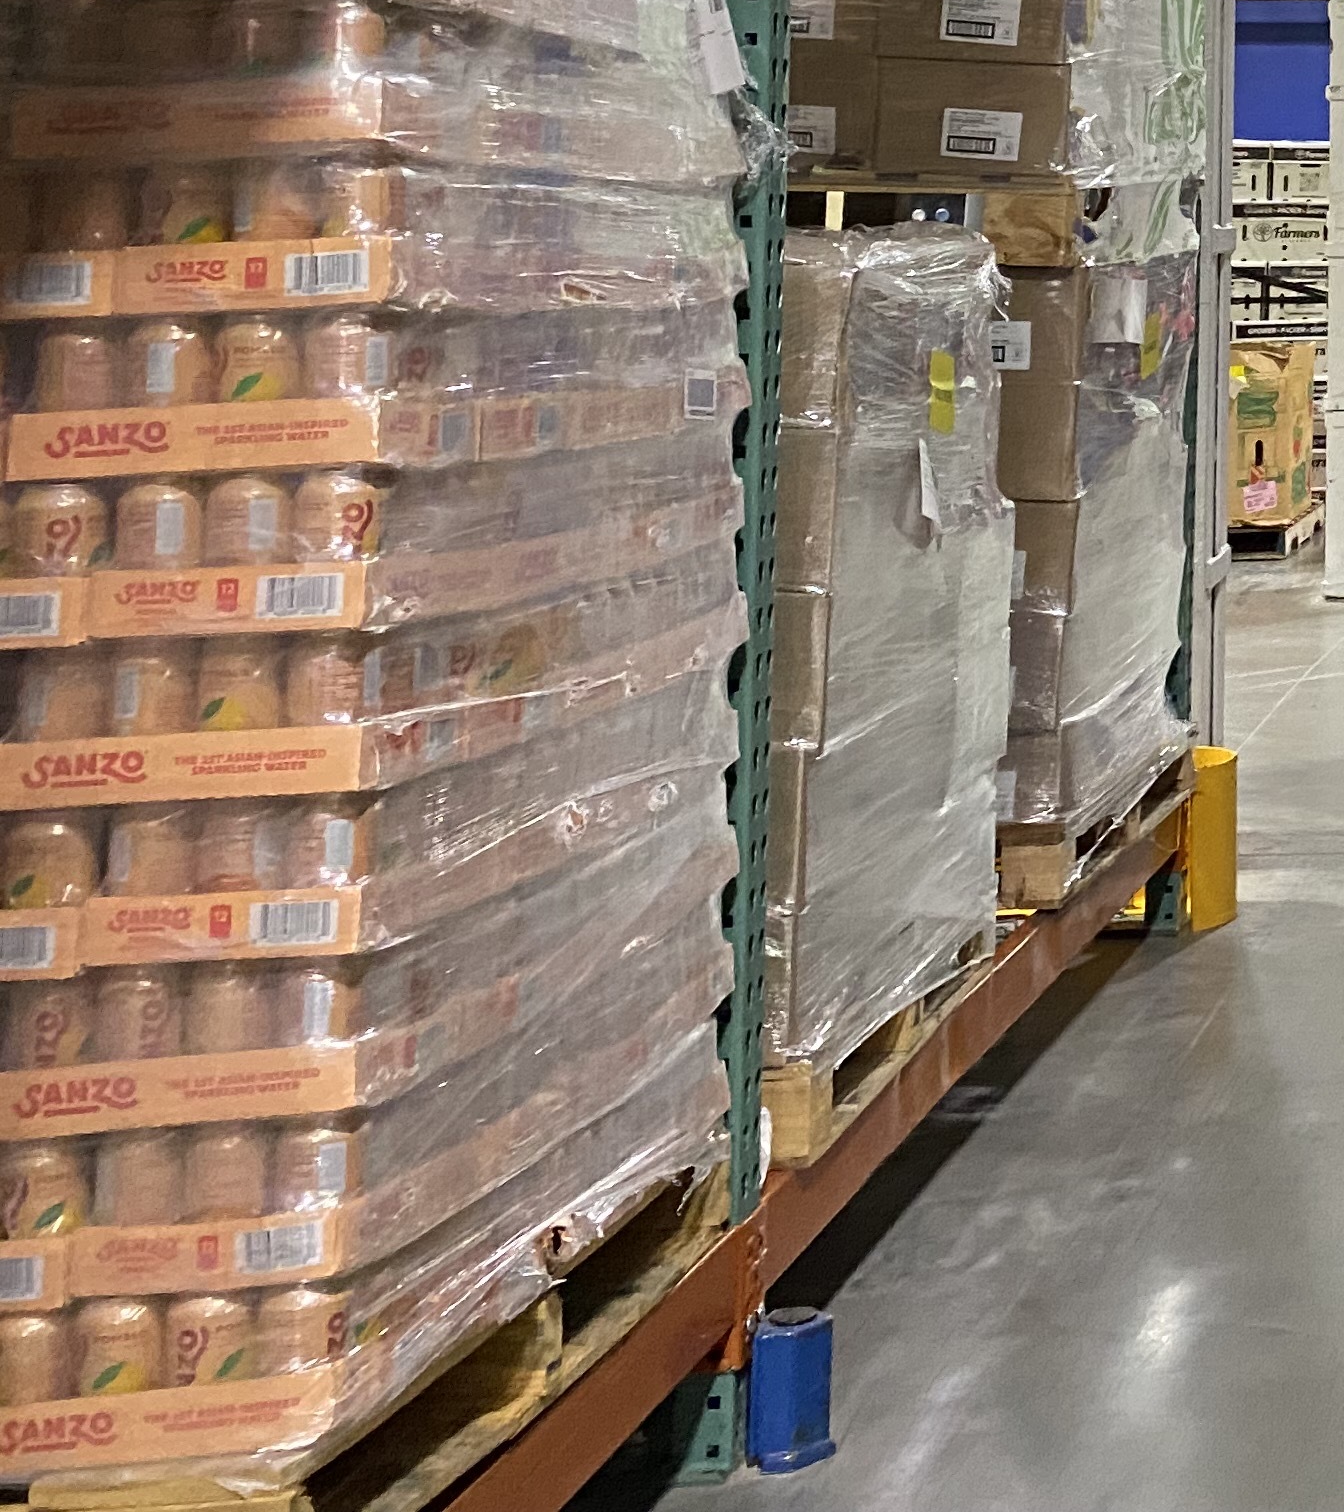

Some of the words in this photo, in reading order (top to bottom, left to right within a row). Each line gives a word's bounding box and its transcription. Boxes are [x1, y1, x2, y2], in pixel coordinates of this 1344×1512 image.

[43, 420, 171, 461] SANZO
[20, 750, 148, 790] SANZO
[11, 1076, 139, 1120] SANZO
